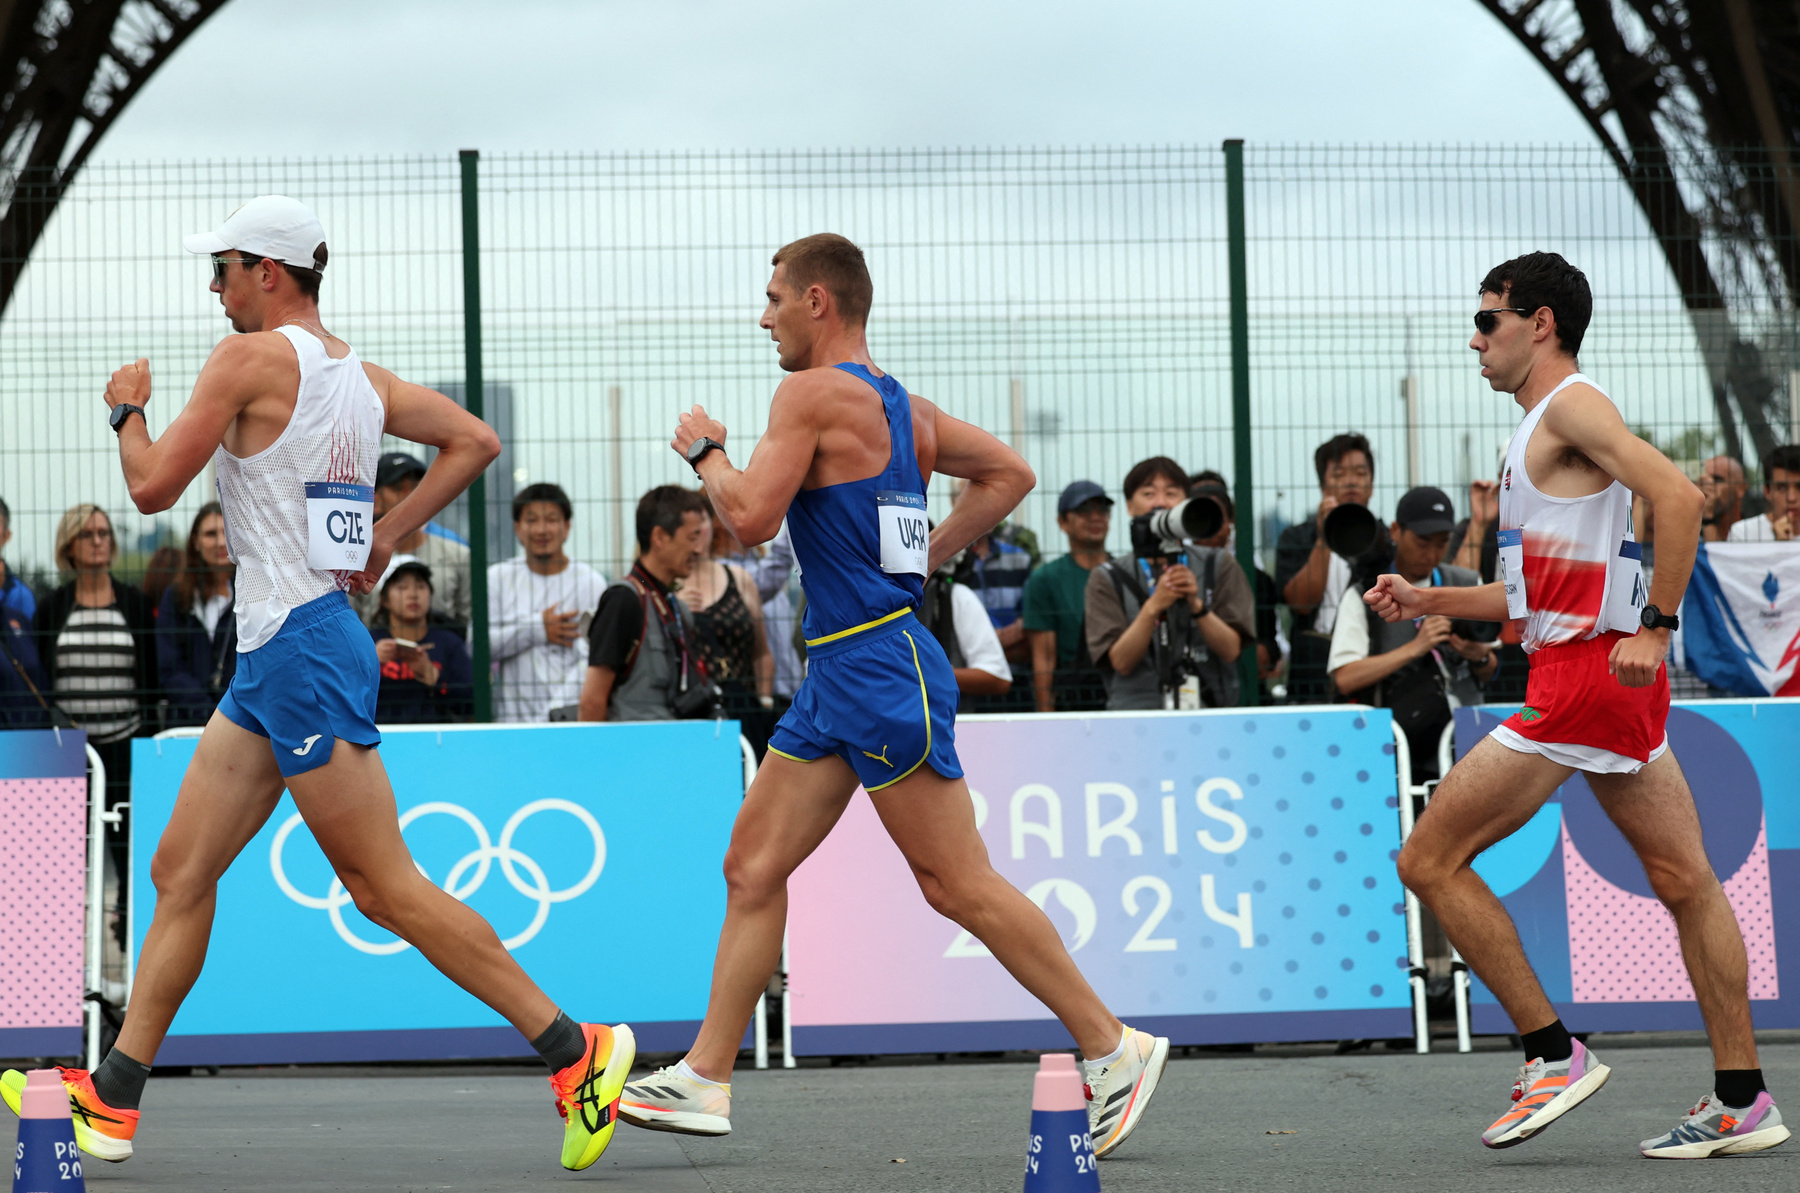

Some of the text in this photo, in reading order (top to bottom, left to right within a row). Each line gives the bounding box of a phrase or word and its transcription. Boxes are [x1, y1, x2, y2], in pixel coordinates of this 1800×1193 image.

[326, 509, 365, 545] CZE
[897, 517, 927, 552] UKR
[58, 1161, 82, 1180] 20
